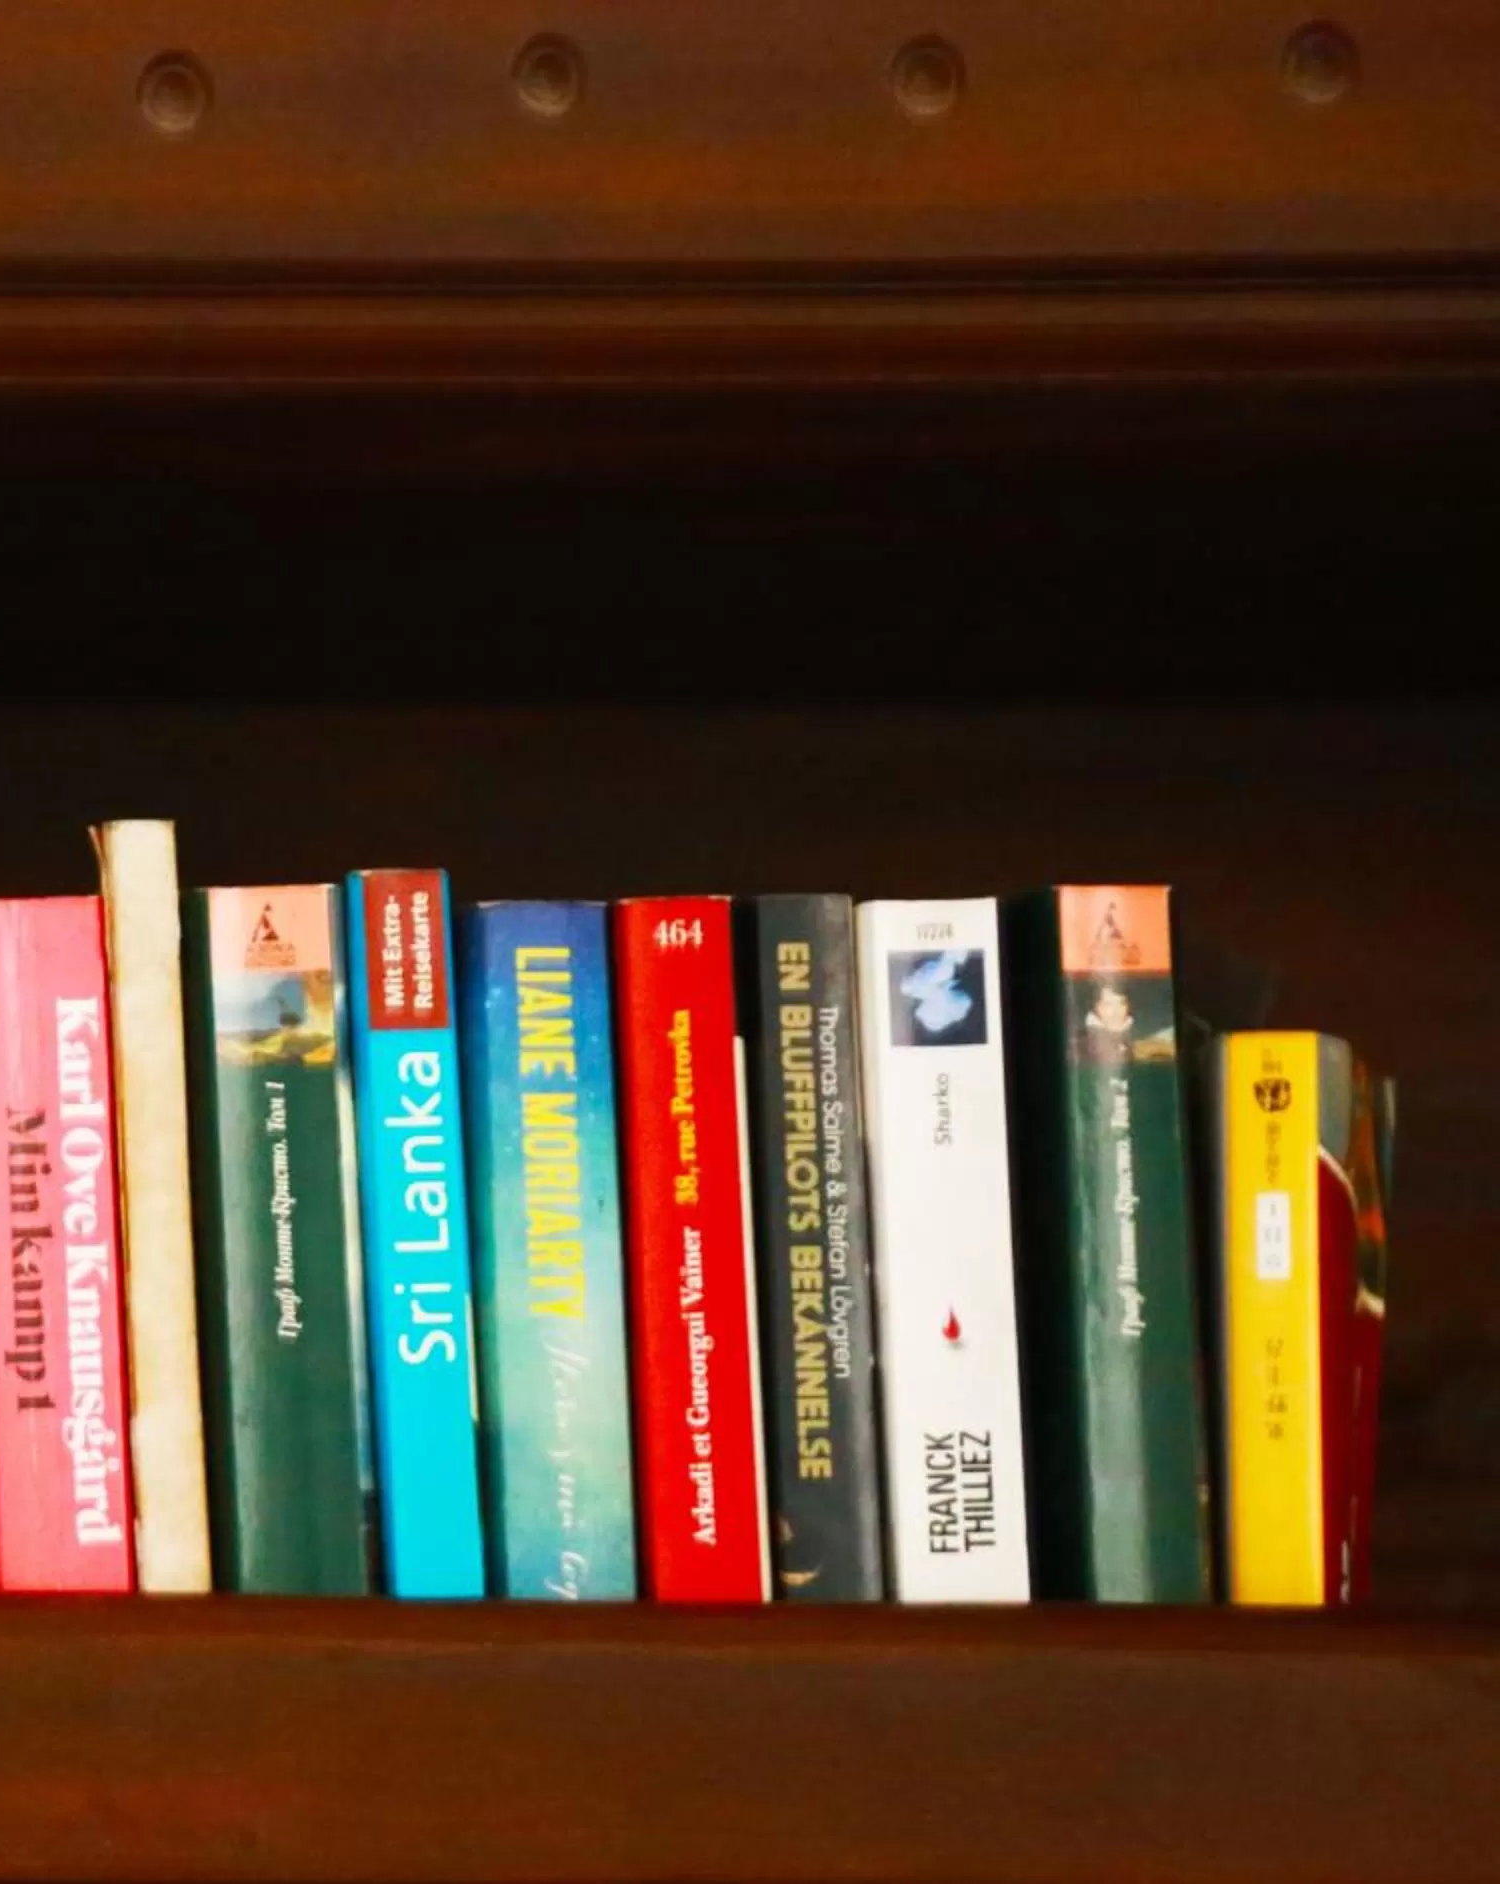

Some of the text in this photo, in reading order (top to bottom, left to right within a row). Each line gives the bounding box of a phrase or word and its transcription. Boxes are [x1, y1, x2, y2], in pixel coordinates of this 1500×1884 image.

[381, 894, 405, 1008] Mit Extra-
[410, 891, 434, 1009] Reisekarte
[653, 919, 704, 949] 464
[777, 942, 811, 992] EN
[668, 1009, 694, 1113] Petrovka
[931, 1073, 953, 1146] Sharko
[8, 1107, 52, 1214] Min
[516, 947, 585, 1320] LIANE MORIARTY
[676, 1120, 698, 1160] rue
[780, 1005, 821, 1233] BLUFFPILOTS
[385, 1052, 455, 1364] Sri Lanka
[819, 1006, 853, 1379] Thomas Salme & Stefan Lövgren
[5, 1225, 53, 1384] kamp
[56, 997, 122, 1545] Karl Ove Knausgård
[683, 1313, 714, 1427] Gueorgui
[690, 1433, 713, 1457] et
[924, 1432, 960, 1554] FRANCK
[959, 1429, 997, 1552] THILLIEZ
[689, 1463, 717, 1546] Arkadi
